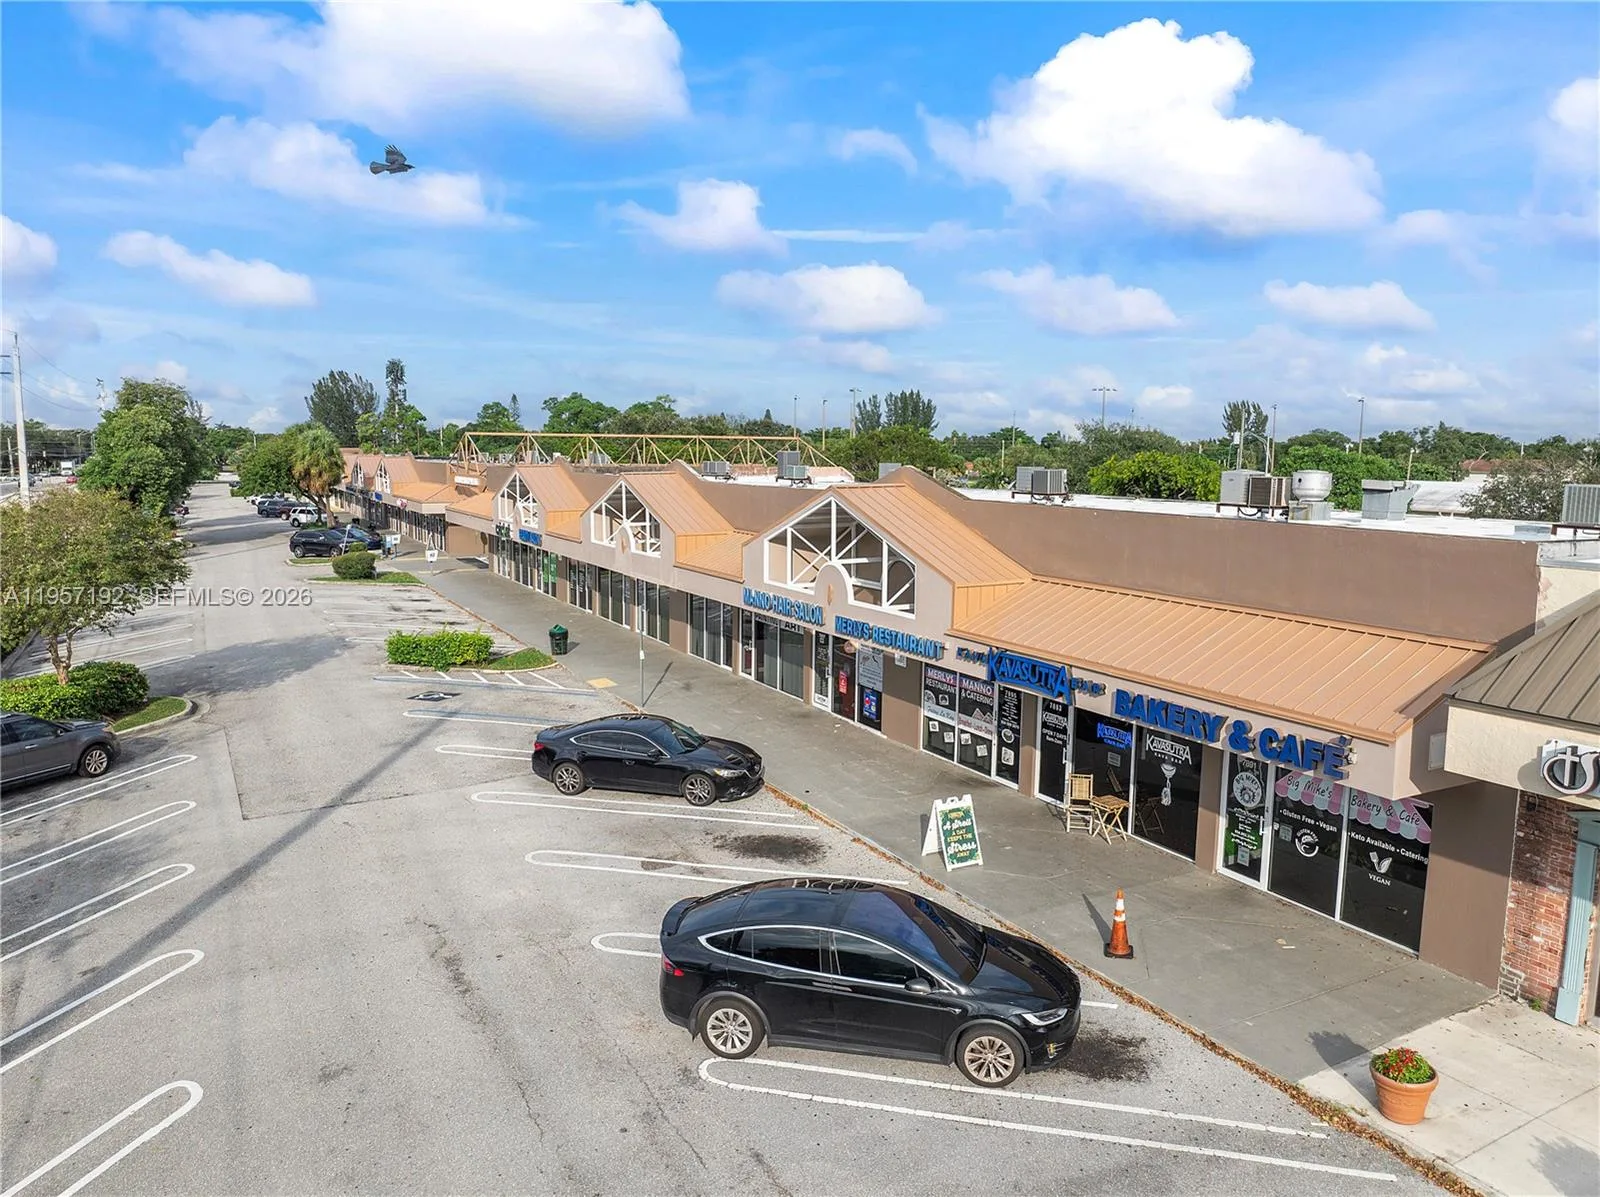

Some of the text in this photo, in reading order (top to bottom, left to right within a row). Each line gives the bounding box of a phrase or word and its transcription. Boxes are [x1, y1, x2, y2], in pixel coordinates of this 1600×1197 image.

[772, 594, 793, 616] HAIR
[794, 600, 824, 626] SALON
[872, 625, 944, 661] RESTAURANT
[962, 679, 993, 695] MANNO
[988, 646, 1072, 706] KAVASUTRA
[967, 691, 994, 706] CATERING
[1115, 688, 1352, 780] BAKERY & CAFÉ
[1146, 733, 1192, 765] KAVASUTRA
[1287, 776, 1333, 799] Big Mike's
[1351, 795, 1382, 816] Bakery
[1385, 806, 1394, 817] &
[1283, 809, 1337, 833] Gluten Free Vegan
[1351, 832, 1429, 865] Keto Available Catering
[1369, 873, 1391, 887] VEGAN
